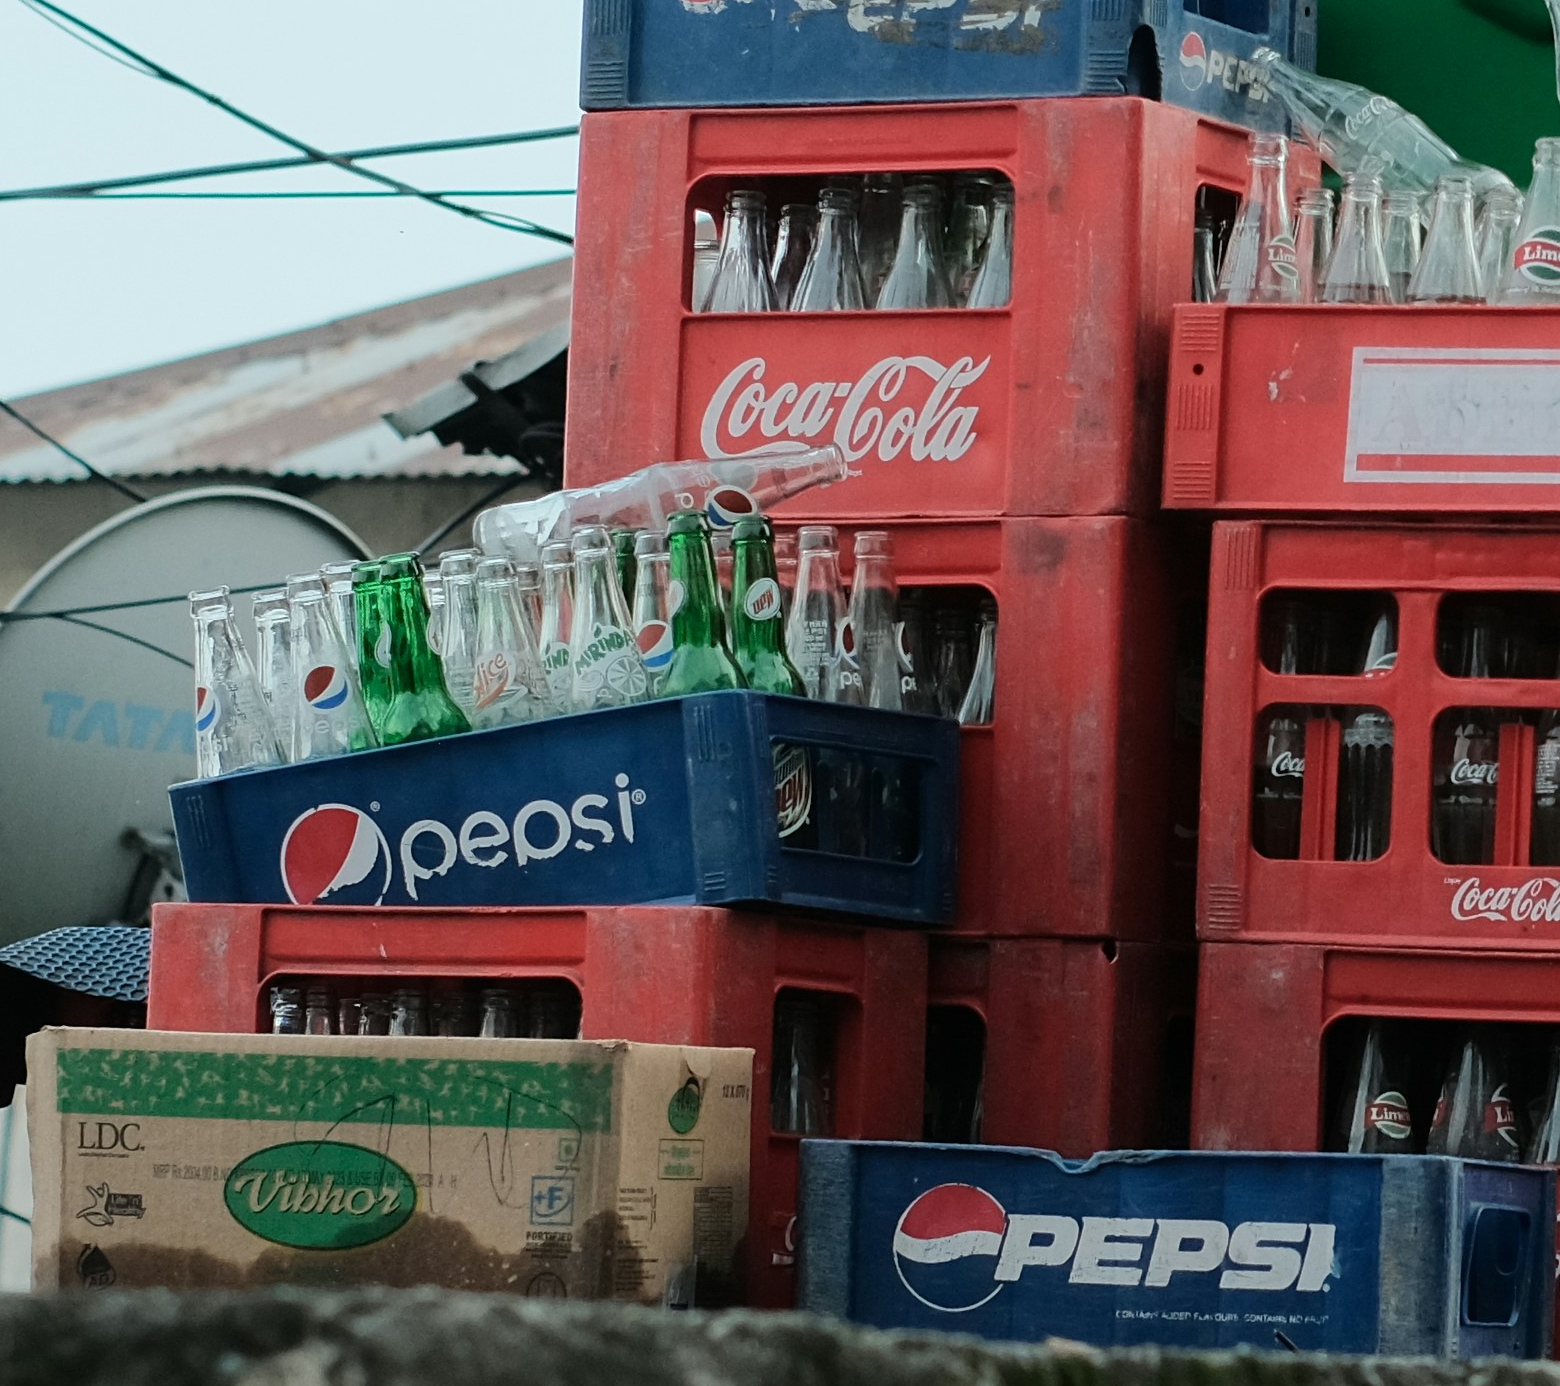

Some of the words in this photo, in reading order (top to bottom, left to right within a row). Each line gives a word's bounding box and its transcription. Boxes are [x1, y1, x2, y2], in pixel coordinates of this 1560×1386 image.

[700, 355, 991, 462] Coca-Cola
[575, 627, 635, 676] MIRINDA
[400, 772, 636, 901] pepsi
[234, 1169, 402, 1217] Vibhor
[994, 1214, 1336, 1292] PEPSI
